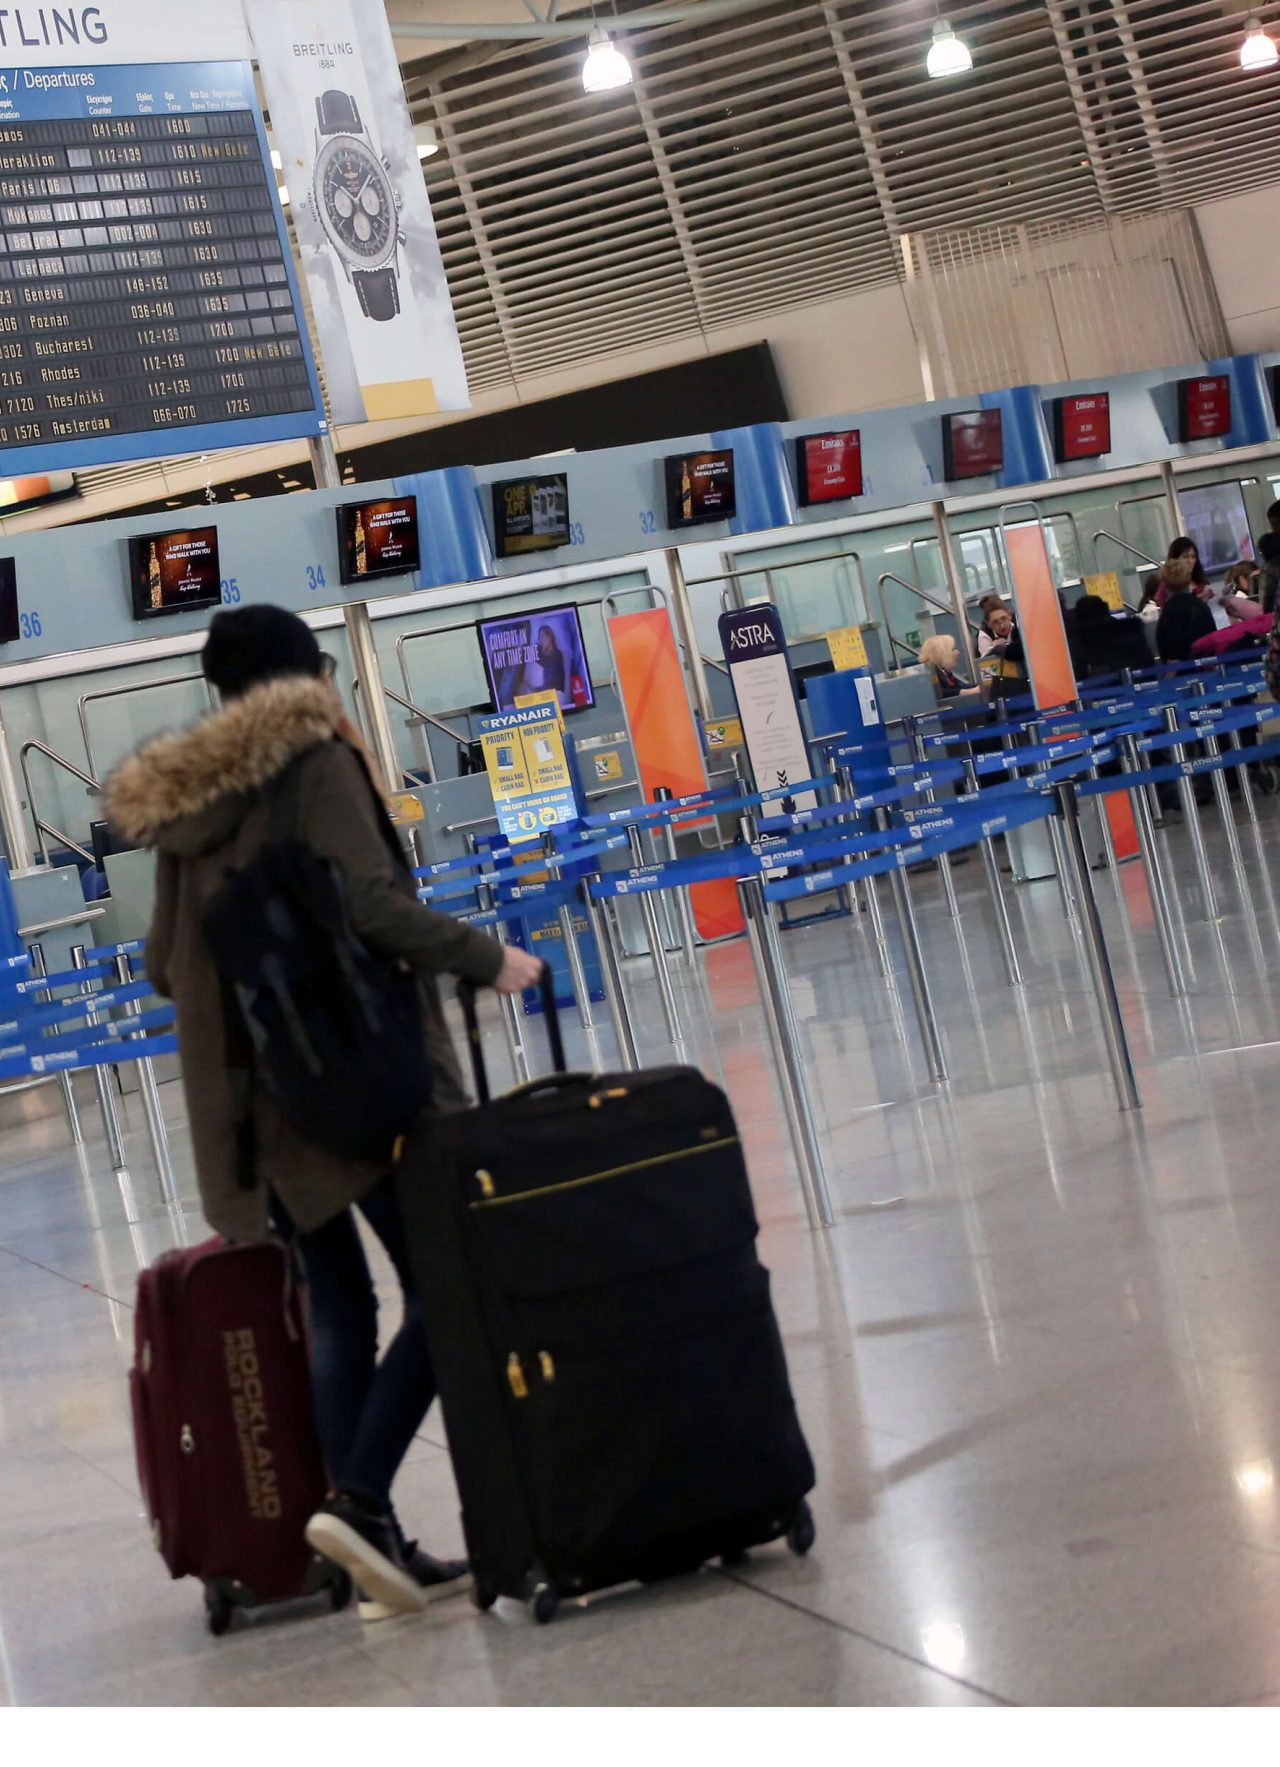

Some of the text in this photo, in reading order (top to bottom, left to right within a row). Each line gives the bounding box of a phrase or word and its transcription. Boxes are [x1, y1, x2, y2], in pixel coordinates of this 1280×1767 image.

[293, 43, 353, 57] BREITLING
[318, 59, 335, 69] 1884
[23, 70, 96, 92] Departures
[97, 149, 141, 164] 112-139
[172, 145, 197, 159] 1610
[23, 272, 224, 303] Geneva 1635
[29, 302, 174, 329] Poznan 036-040
[46, 373, 245, 409] Thes/niki 1700
[13, 398, 251, 441] 1576 Amsterdam 066-070 1725
[639, 510, 657, 534] 32
[306, 564, 326, 590] 34
[220, 578, 241, 605] 35
[20, 610, 42, 640] 36
[730, 622, 775, 650] ASTRA
[489, 630, 519, 650] COMFORT
[493, 651, 507, 669] ANY
[524, 644, 540, 664] ZONE
[490, 707, 552, 728] RYANAIR
[486, 731, 515, 746] PRIORITY
[534, 723, 555, 735] PRIORITY
[1192, 755, 1222, 768] ATHENS
[921, 817, 954, 830] ATHENS
[772, 849, 804, 861] ATHENS
[520, 883, 546, 894] ATHENS
[627, 875, 658, 886] ATHENS
[236, 1328, 282, 1519] ROCKLAND
